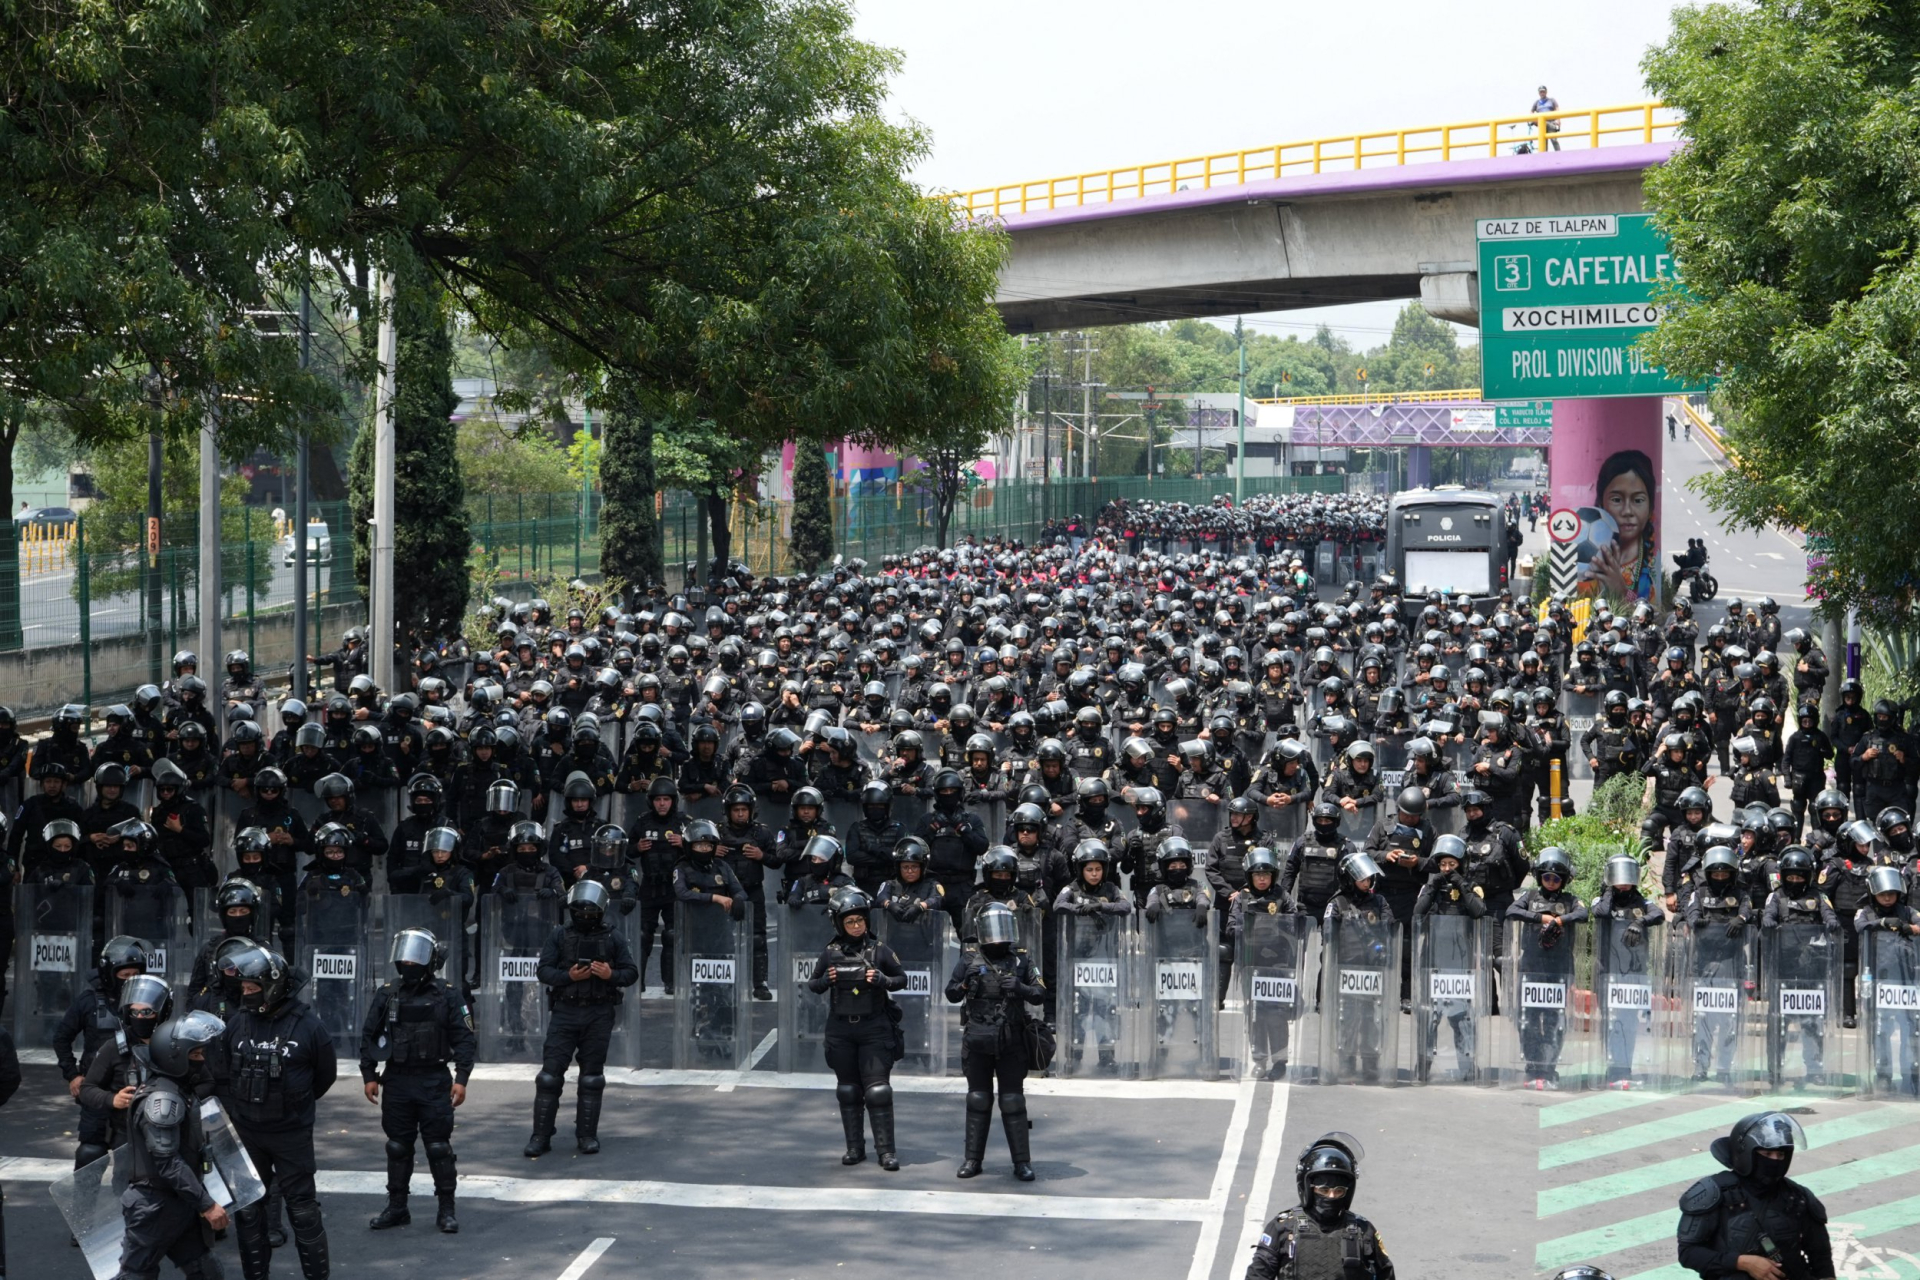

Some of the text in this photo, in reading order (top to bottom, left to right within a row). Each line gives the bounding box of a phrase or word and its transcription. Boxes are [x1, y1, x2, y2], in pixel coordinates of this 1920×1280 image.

[1486, 219, 1606, 235] CALZ DE TLALPAN
[1505, 254, 1684, 286] 3 CAFETALES
[1513, 307, 1657, 327] XOCHIMILCO
[1512, 349, 1551, 378] PROL
[1557, 347, 1622, 377] DIVISION
[36, 945, 70, 961] POLICIA
[316, 958, 353, 975] POLICIA
[694, 963, 731, 980] POLICIA
[1077, 966, 1114, 983] POLICIA
[1161, 973, 1196, 989] POLICIA
[1255, 981, 1292, 998] POLICIA
[1341, 974, 1379, 991] POLICIA
[1433, 979, 1471, 994] POLICIA
[1524, 987, 1562, 1003] POLICIA
[1611, 988, 1648, 1005] POLICIA
[1696, 991, 1734, 1008] POLICIA
[1783, 994, 1821, 1010] POLICIA
[1879, 989, 1917, 1005] POLICIA
